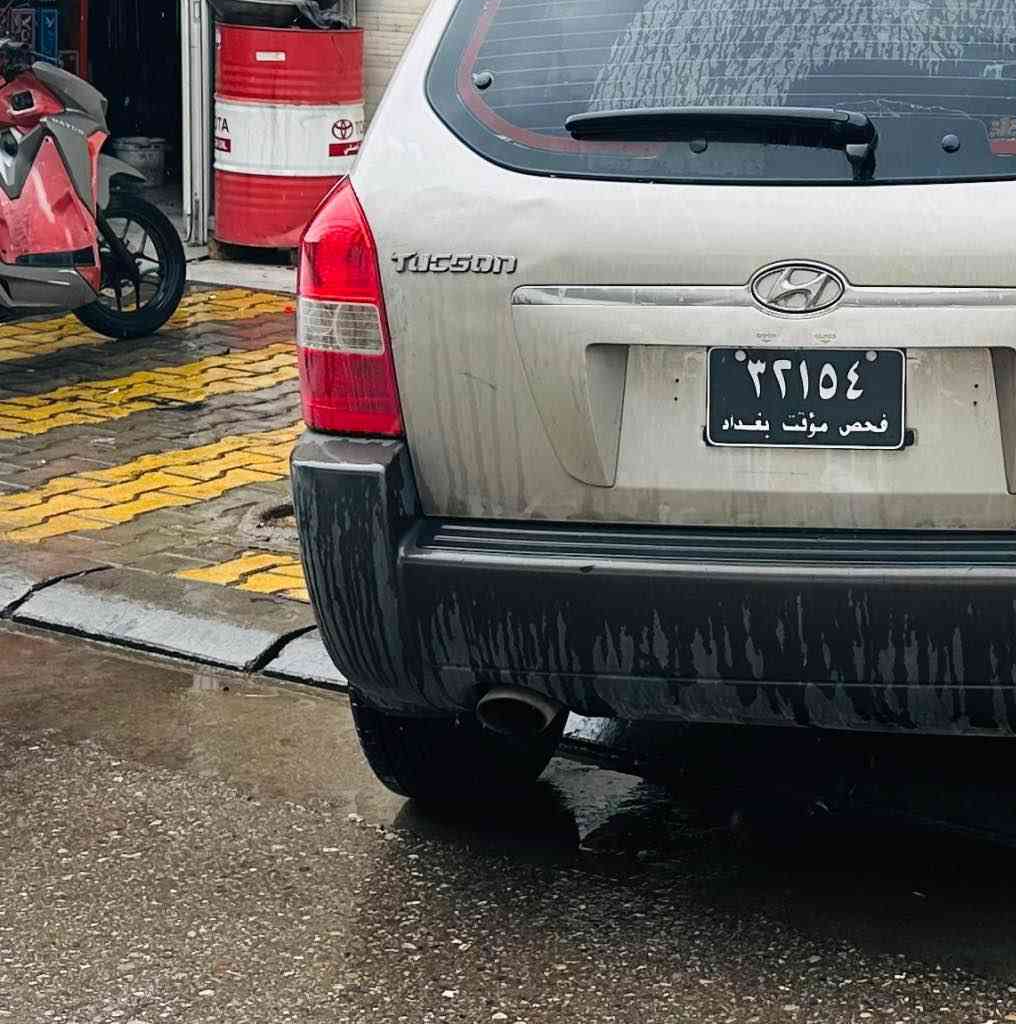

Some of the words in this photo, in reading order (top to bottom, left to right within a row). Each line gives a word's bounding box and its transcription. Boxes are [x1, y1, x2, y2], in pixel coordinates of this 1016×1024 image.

[747, 359, 864, 400] ٣٢١٥٤
[722, 412, 769, 439] بغداد
[839, 413, 889, 437] فحص
